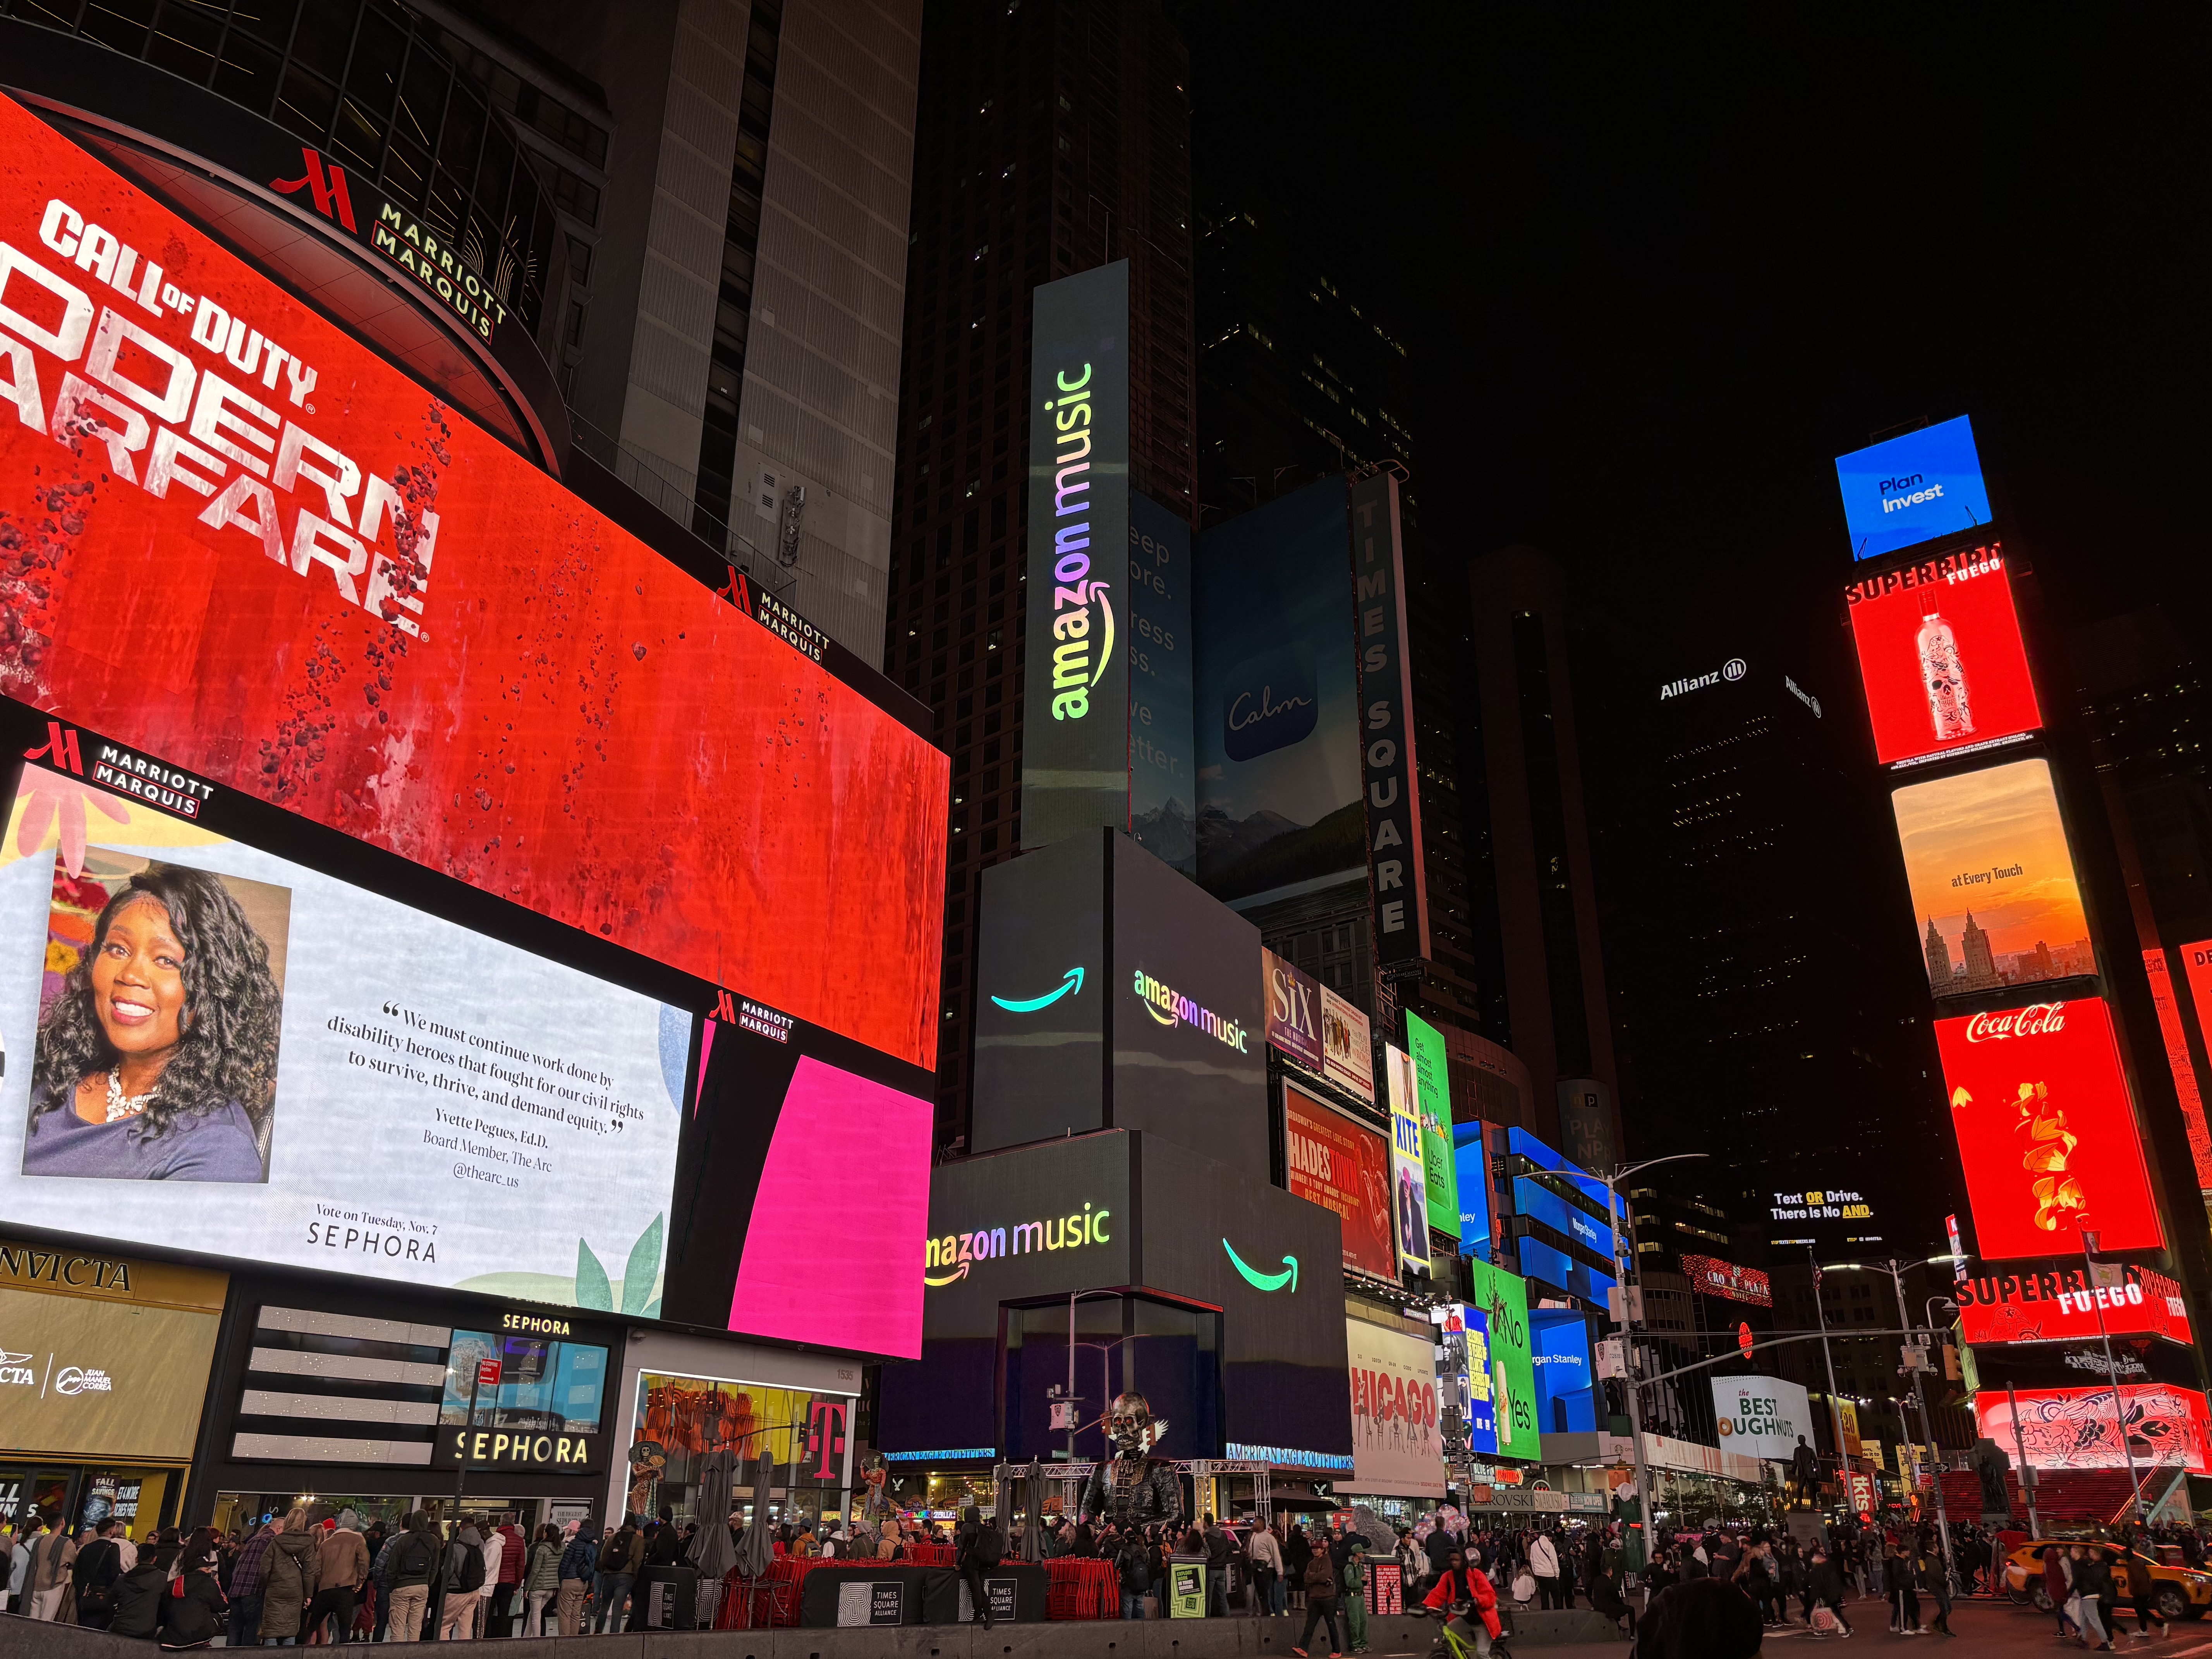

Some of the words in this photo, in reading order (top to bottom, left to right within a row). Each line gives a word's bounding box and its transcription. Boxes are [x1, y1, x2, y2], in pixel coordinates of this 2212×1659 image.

[39, 199, 163, 318] CALL
[162, 282, 195, 315] OF
[380, 203, 506, 324] MARRIOTT
[376, 228, 491, 338] MARQUIS
[1044, 362, 1092, 517] music
[1879, 473, 1923, 495] Plan
[1882, 483, 1944, 514] Invest
[1357, 500, 1387, 673] TIMES
[1947, 559, 2001, 586] FUEGO
[760, 609, 820, 661] MARQUIS
[762, 592, 829, 649] MARRIOTT
[1052, 522, 1091, 721] amazon
[1661, 671, 1719, 700] Allianz
[1785, 675, 1811, 708] Allianz
[1228, 685, 1312, 731] Calm
[102, 746, 213, 800] MARRIOTT
[97, 765, 194, 814] MARQUIS
[1367, 700, 1406, 933] SQUARE
[1951, 875, 1963, 887] at
[1963, 872, 1991, 885] Every
[1992, 864, 2023, 879] Touch
[742, 1001, 793, 1029] MARRIOTT
[1134, 970, 1198, 1027] amazon
[1200, 1007, 1247, 1054] music
[1273, 969, 1317, 1041] SIX
[741, 1015, 786, 1041] MARQUIS
[1966, 1001, 2066, 1043] Coca-Cola
[430, 1023, 466, 1044] must
[469, 1032, 529, 1063] continue
[532, 1054, 565, 1074] work
[567, 1063, 597, 1084] done
[600, 1071, 614, 1091] by
[1352, 1046, 1370, 1070] WRONG
[1415, 1038, 1424, 1052] Get
[327, 1016, 403, 1052] disability
[406, 1037, 455, 1066] heroes
[459, 1054, 487, 1074] that
[489, 1062, 534, 1089] fought
[537, 1075, 556, 1095] for
[558, 1085, 580, 1103] our
[582, 1092, 608, 1110] civil
[610, 1099, 644, 1121] rights
[1417, 1051, 1432, 1069] almost
[1417, 1064, 1433, 1081] almost
[349, 1050, 366, 1066] to
[369, 1056, 428, 1085] survive,
[432, 1072, 478, 1100] thrive,
[482, 1089, 508, 1107] and
[511, 1095, 564, 1122] demand
[1419, 1076, 1438, 1098] anything
[435, 1108, 472, 1129] Yvette
[475, 1119, 518, 1144] Pegues,
[520, 1130, 548, 1149] Ed.D.
[1313, 1122, 1332, 1139] GREATEST
[1333, 1132, 1342, 1144] LOVE
[1343, 1137, 1354, 1151] STORY
[1394, 1111, 1419, 1158] XITE
[424, 1130, 458, 1150] Board
[460, 1139, 509, 1164] Member,
[512, 1151, 532, 1168] The
[533, 1156, 553, 1173] Arc
[1428, 1147, 1443, 1170] Uber
[453, 1163, 519, 1188] @thearc_us
[1291, 1170, 1308, 1185] WINNER!
[1313, 1179, 1322, 1191] TONY
[1341, 1192, 1359, 1207] INCLUDING
[1430, 1168, 1445, 1189] Eats
[1305, 1188, 1321, 1205] BEST
[1323, 1196, 1350, 1220] MUSICAL
[1774, 1193, 1803, 1204] Text
[1806, 1192, 1824, 1203] OR
[1826, 1190, 1863, 1202] Drive.
[316, 1204, 341, 1218] Vote
[344, 1210, 358, 1222] on
[361, 1212, 406, 1232] Tuesday,
[409, 1220, 429, 1235] Nov.
[432, 1224, 438, 1235] 7
[1771, 1208, 1807, 1219] There
[1809, 1207, 1820, 1218] Is
[1823, 1206, 1840, 1218] No
[1843, 1205, 1874, 1217] AND.
[1013, 1202, 1110, 1252] music
[1573, 1217, 1585, 1235] Morgan
[1585, 1224, 1597, 1243] Stanley
[307, 1222, 435, 1264] SEPHORA
[1745, 1279, 1768, 1295] PLAZA
[2057, 1283, 2143, 1314] FUEGO
[2166, 1297, 2186, 1317] FUEGO
[503, 1313, 570, 1335] SEPHORA
[1503, 1309, 1523, 1348] No
[837, 1369, 854, 1380] 1535
[1553, 1354, 1582, 1366] Stanley
[82, 1382, 112, 1391] CORREA
[84, 1376, 111, 1384] MANUEL
[1739, 1388, 1749, 1396] the
[1507, 1388, 1530, 1430] Yes
[1740, 1398, 1778, 1416] BEST
[455, 1431, 588, 1463] SEPHORA
[920, 1450, 942, 1460] EAGLE
[945, 1449, 992, 1458] OUTFITTERS
[1228, 1444, 1277, 1463] AMERICAN
[1281, 1449, 1306, 1465] EAGLE
[1308, 1451, 1354, 1470] OUTFITTERS
[96, 1478, 115, 1486] FALL
[1474, 1463, 1486, 1475] BLUE
[1535, 1493, 1562, 1509] SWAROVSKI
[1852, 1476, 1870, 1511] tkts
[874, 1600, 898, 1608] SQUARE
[877, 1591, 897, 1599] TIMES
